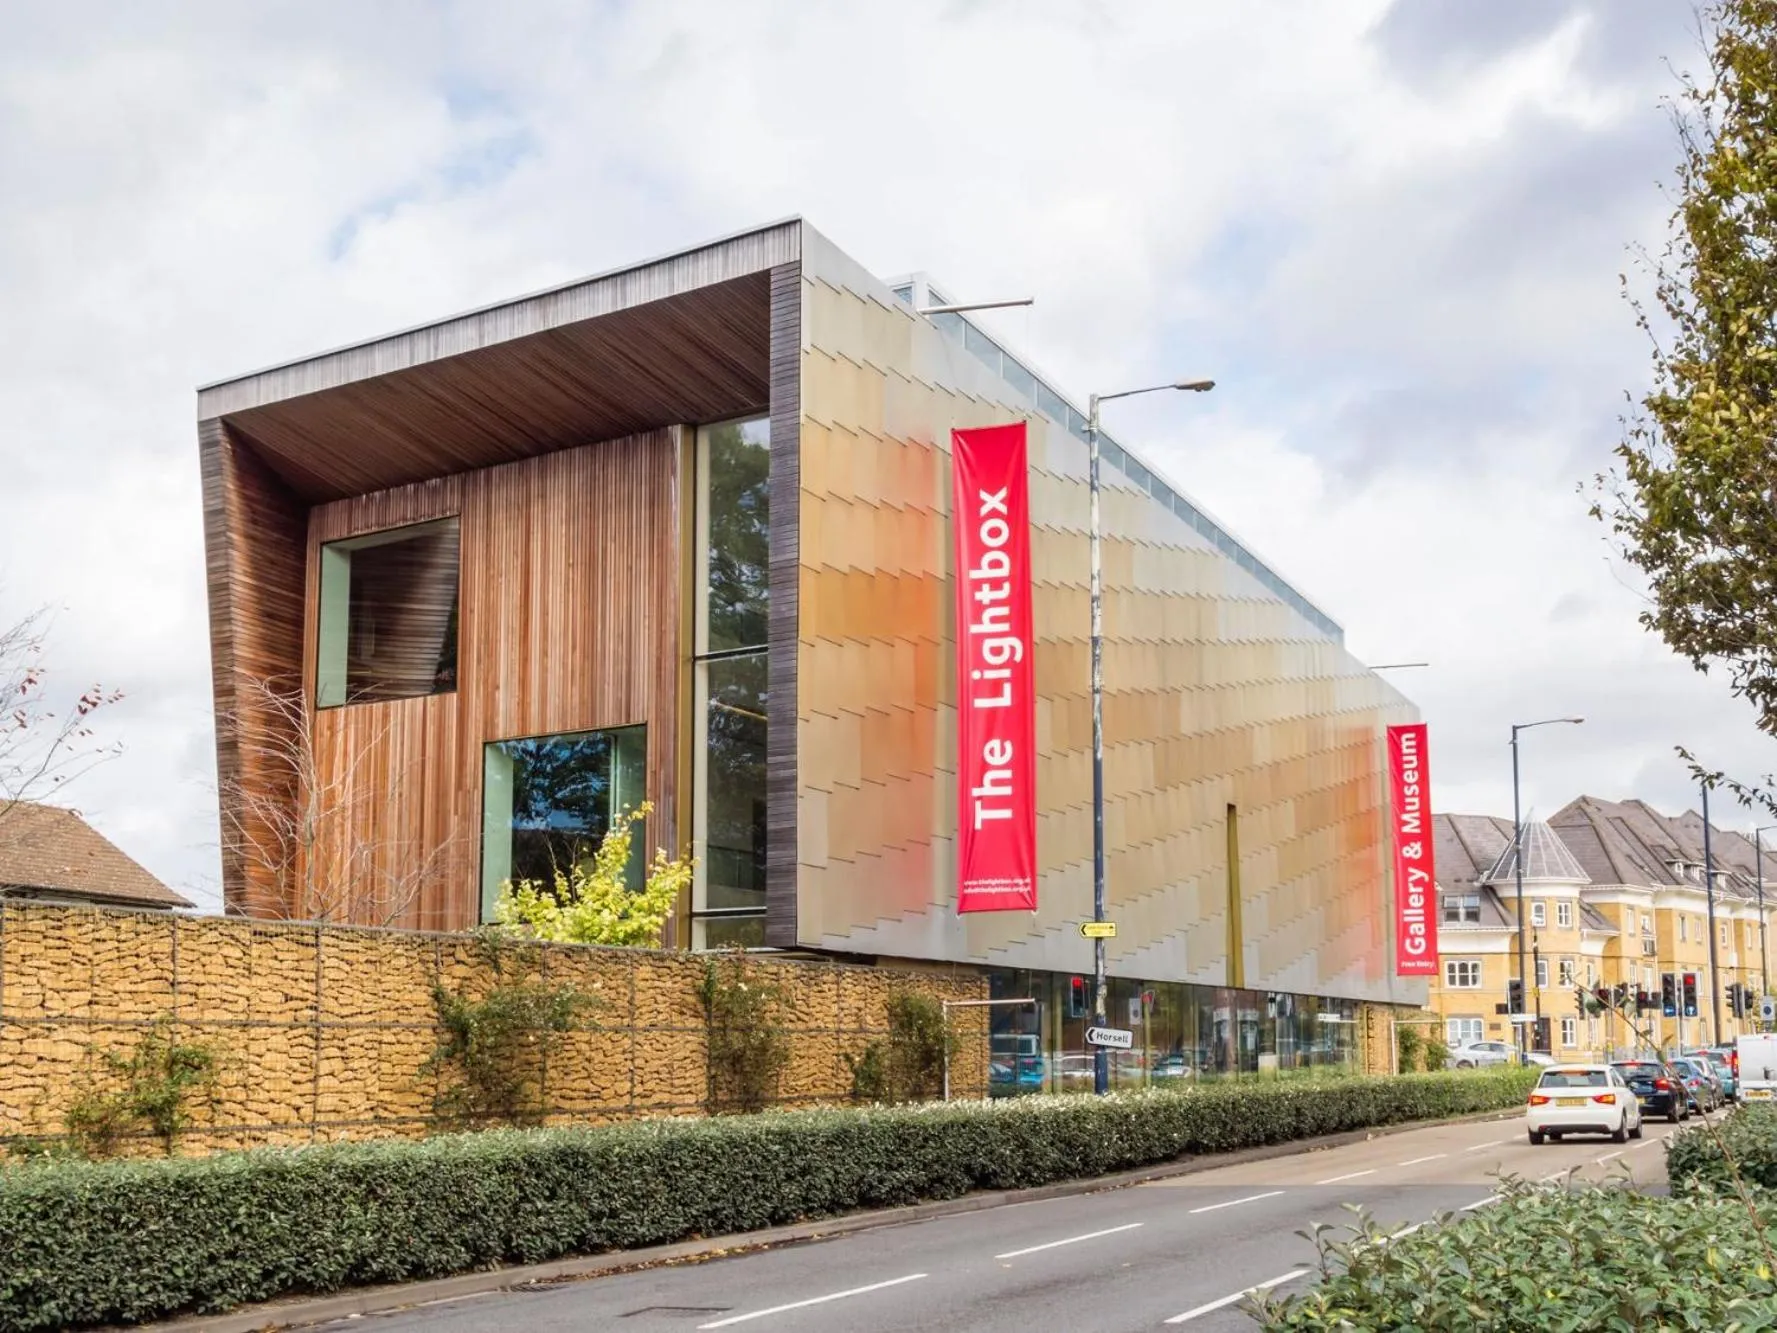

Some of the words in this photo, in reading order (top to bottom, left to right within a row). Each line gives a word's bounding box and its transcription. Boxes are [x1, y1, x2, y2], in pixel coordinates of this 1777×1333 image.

[968, 487, 1024, 709] Lightbox
[971, 738, 1013, 830] The
[1402, 733, 1421, 833] Museum
[1402, 843, 1422, 860] &
[1404, 867, 1429, 955] Gallery
[1096, 1031, 1129, 1043] Horsell
